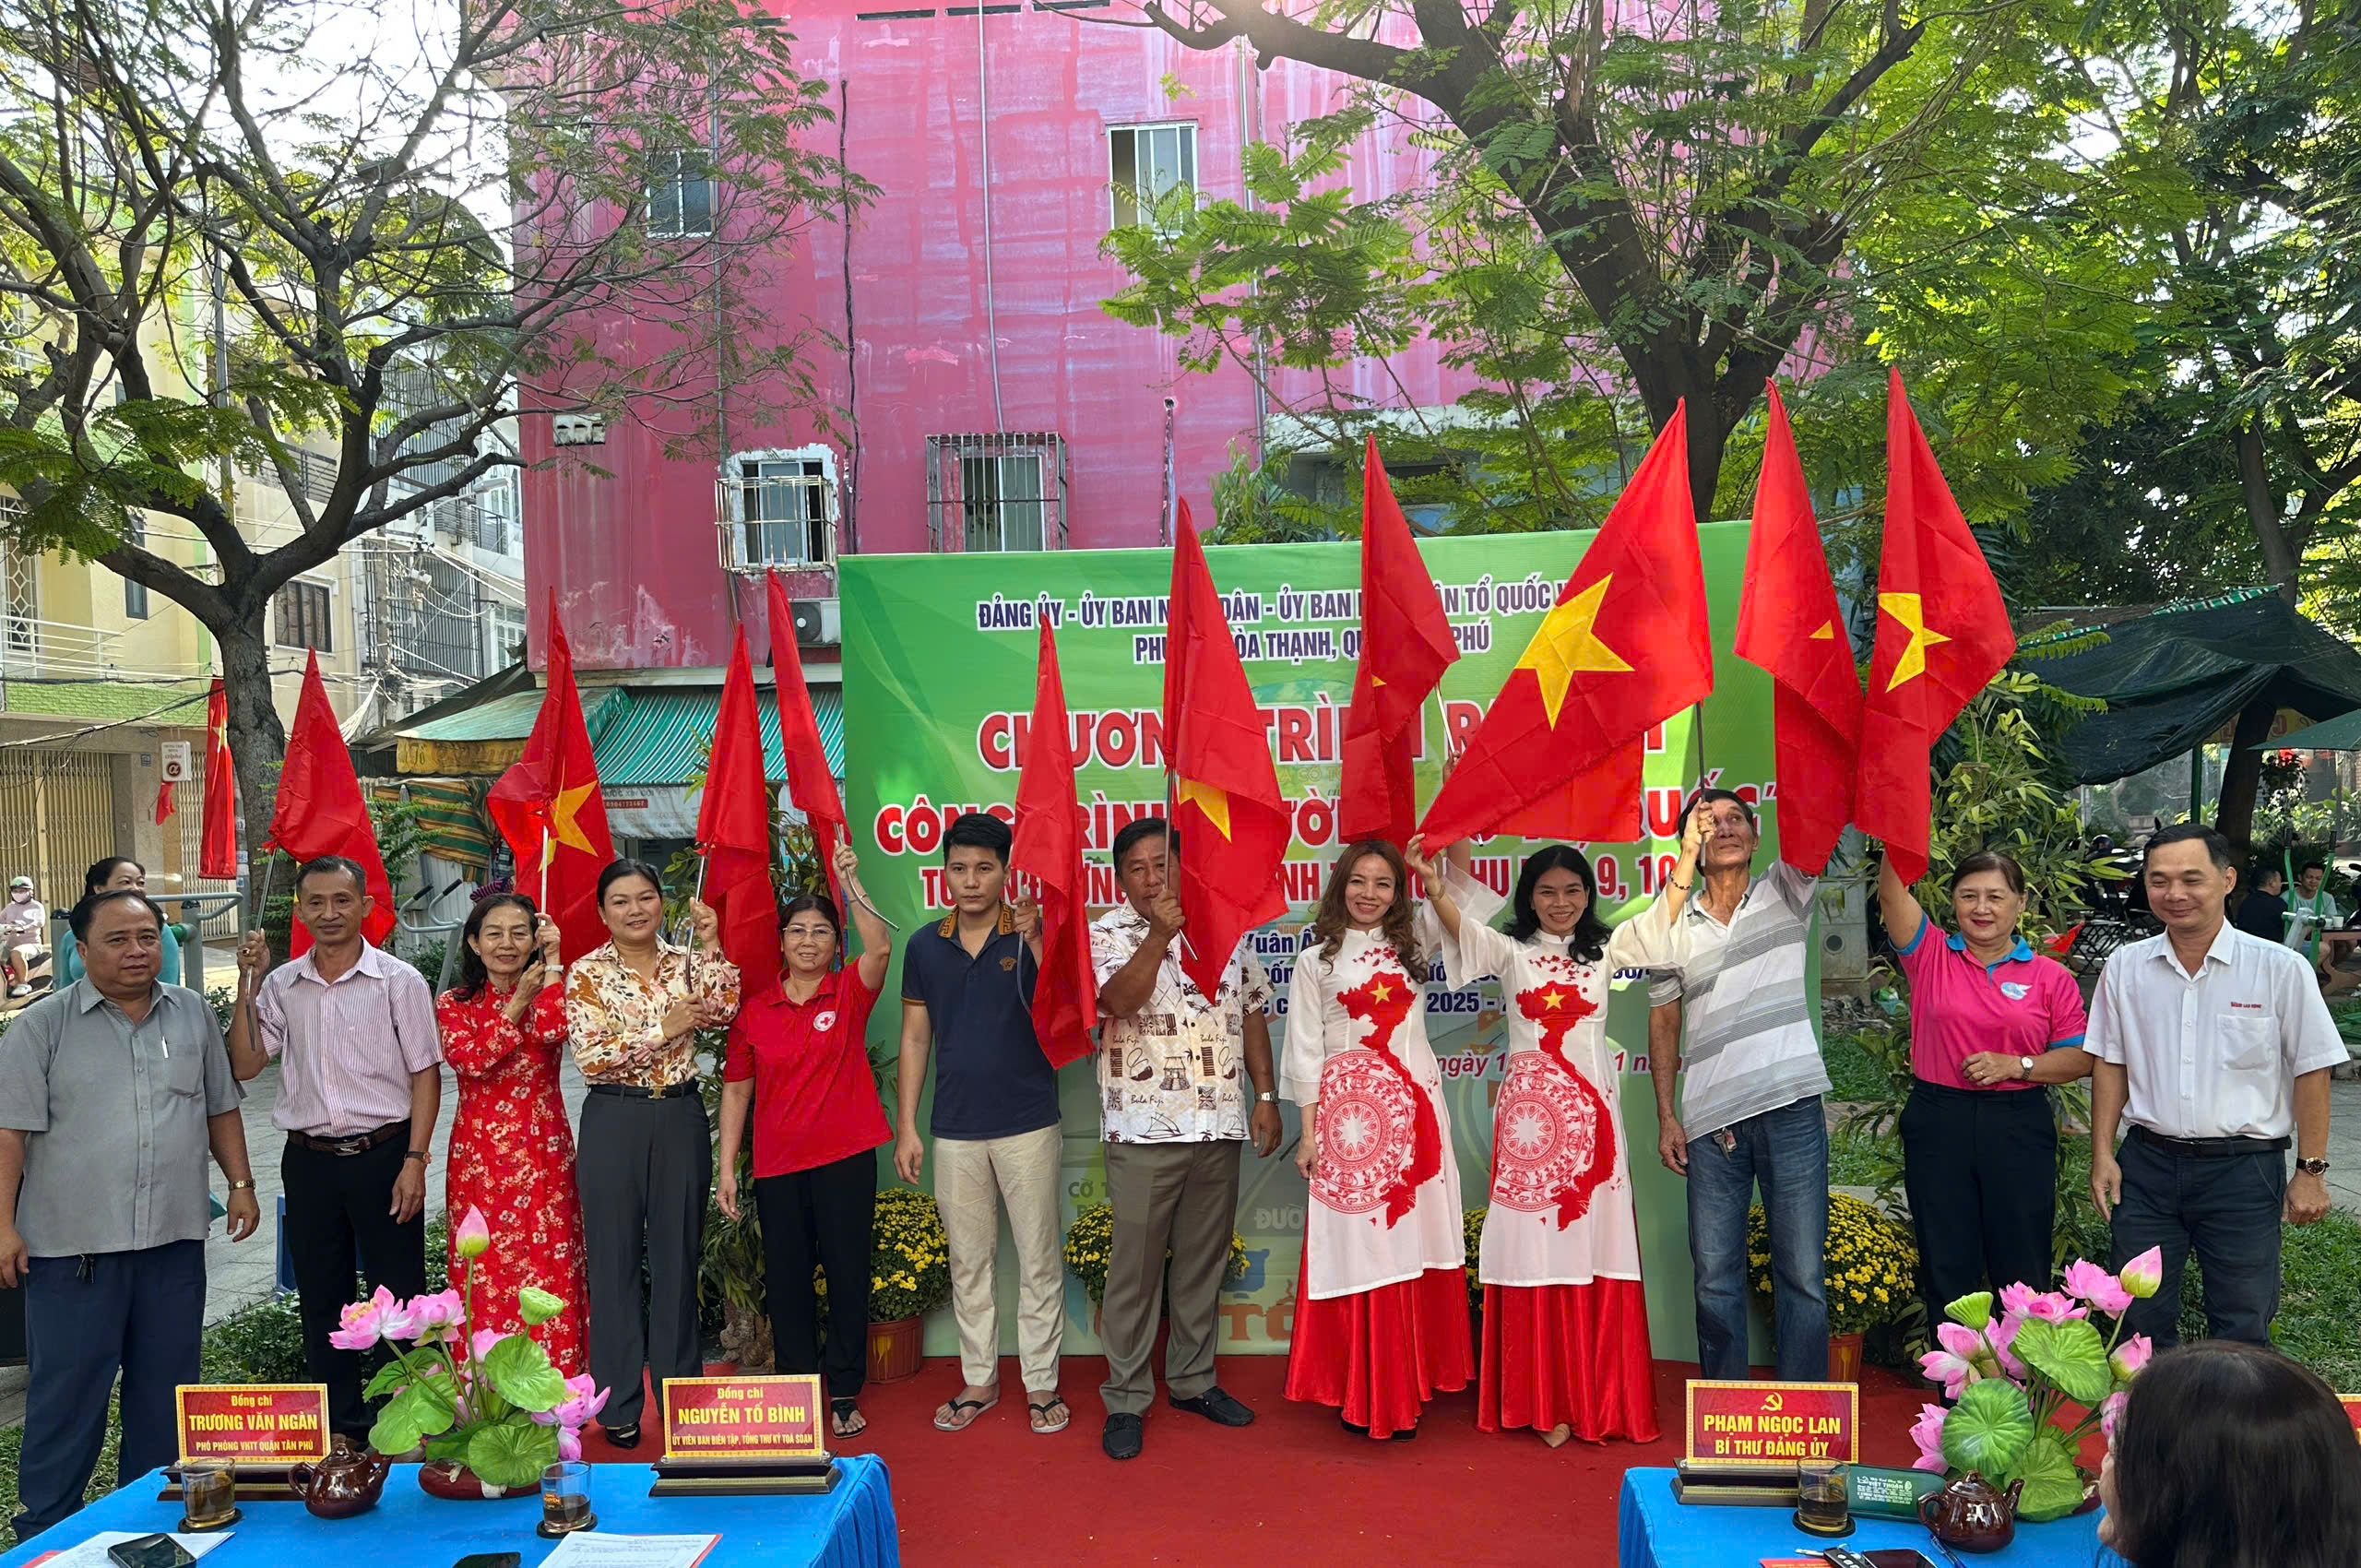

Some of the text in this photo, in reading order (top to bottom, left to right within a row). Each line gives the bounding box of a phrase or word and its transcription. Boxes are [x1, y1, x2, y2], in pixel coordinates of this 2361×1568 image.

[979, 593, 1032, 628] ĐẢNG
[1082, 592, 1107, 625] ỦY
[1112, 600, 1152, 624] BAN
[1279, 586, 1304, 620] ỦY
[1311, 592, 1351, 618] BAN
[1465, 576, 1490, 612] TỔ
[1496, 575, 1550, 613] QUỐC
[1265, 631, 1336, 663] THẠNH,
[1596, 856, 1627, 900] 9,
[1427, 992, 1479, 1013] 2025
[1437, 1052, 1488, 1077] ngày
[188, 1410, 318, 1431] TRƯƠNG VĂN NGÀN
[678, 1401, 805, 1425] NGUYỄN TỐ BÌNH
[1703, 1414, 1841, 1437] PHẠM NGỌC LAN
[281, 1440, 297, 1451] TÂN
[1714, 1435, 1830, 1457] BÍ THƯ ĐẢNG ỦY
